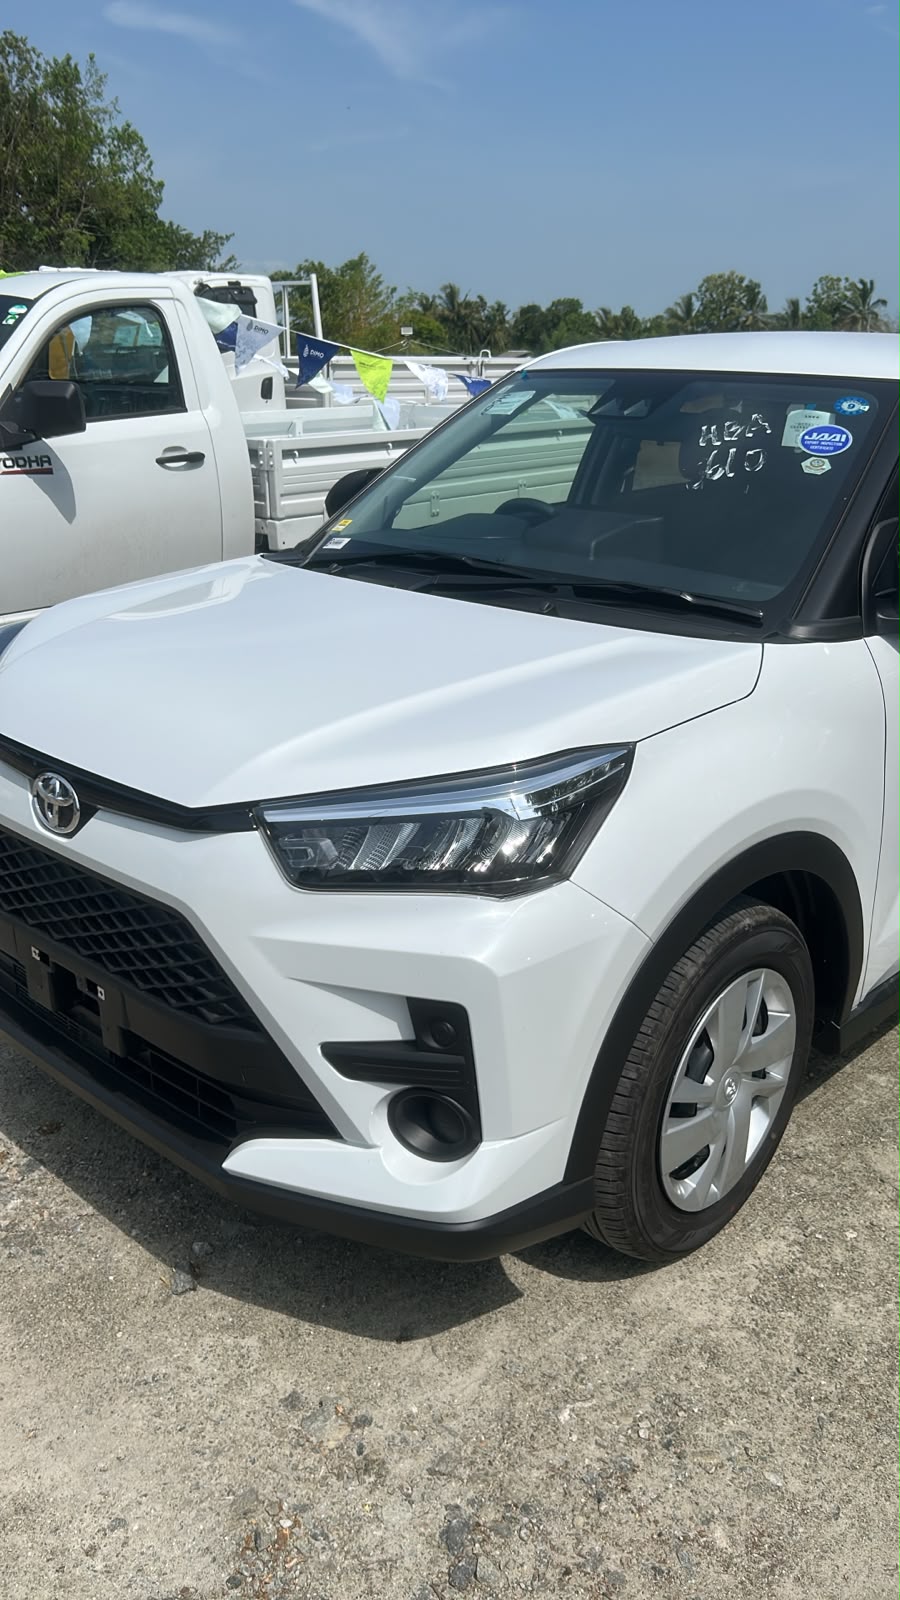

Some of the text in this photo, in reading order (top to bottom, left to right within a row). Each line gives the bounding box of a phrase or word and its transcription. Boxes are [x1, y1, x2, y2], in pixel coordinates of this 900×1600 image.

[253, 325, 269, 335] DIMO
[309, 349, 325, 359] DIMO
[804, 432, 847, 442] JAAI
